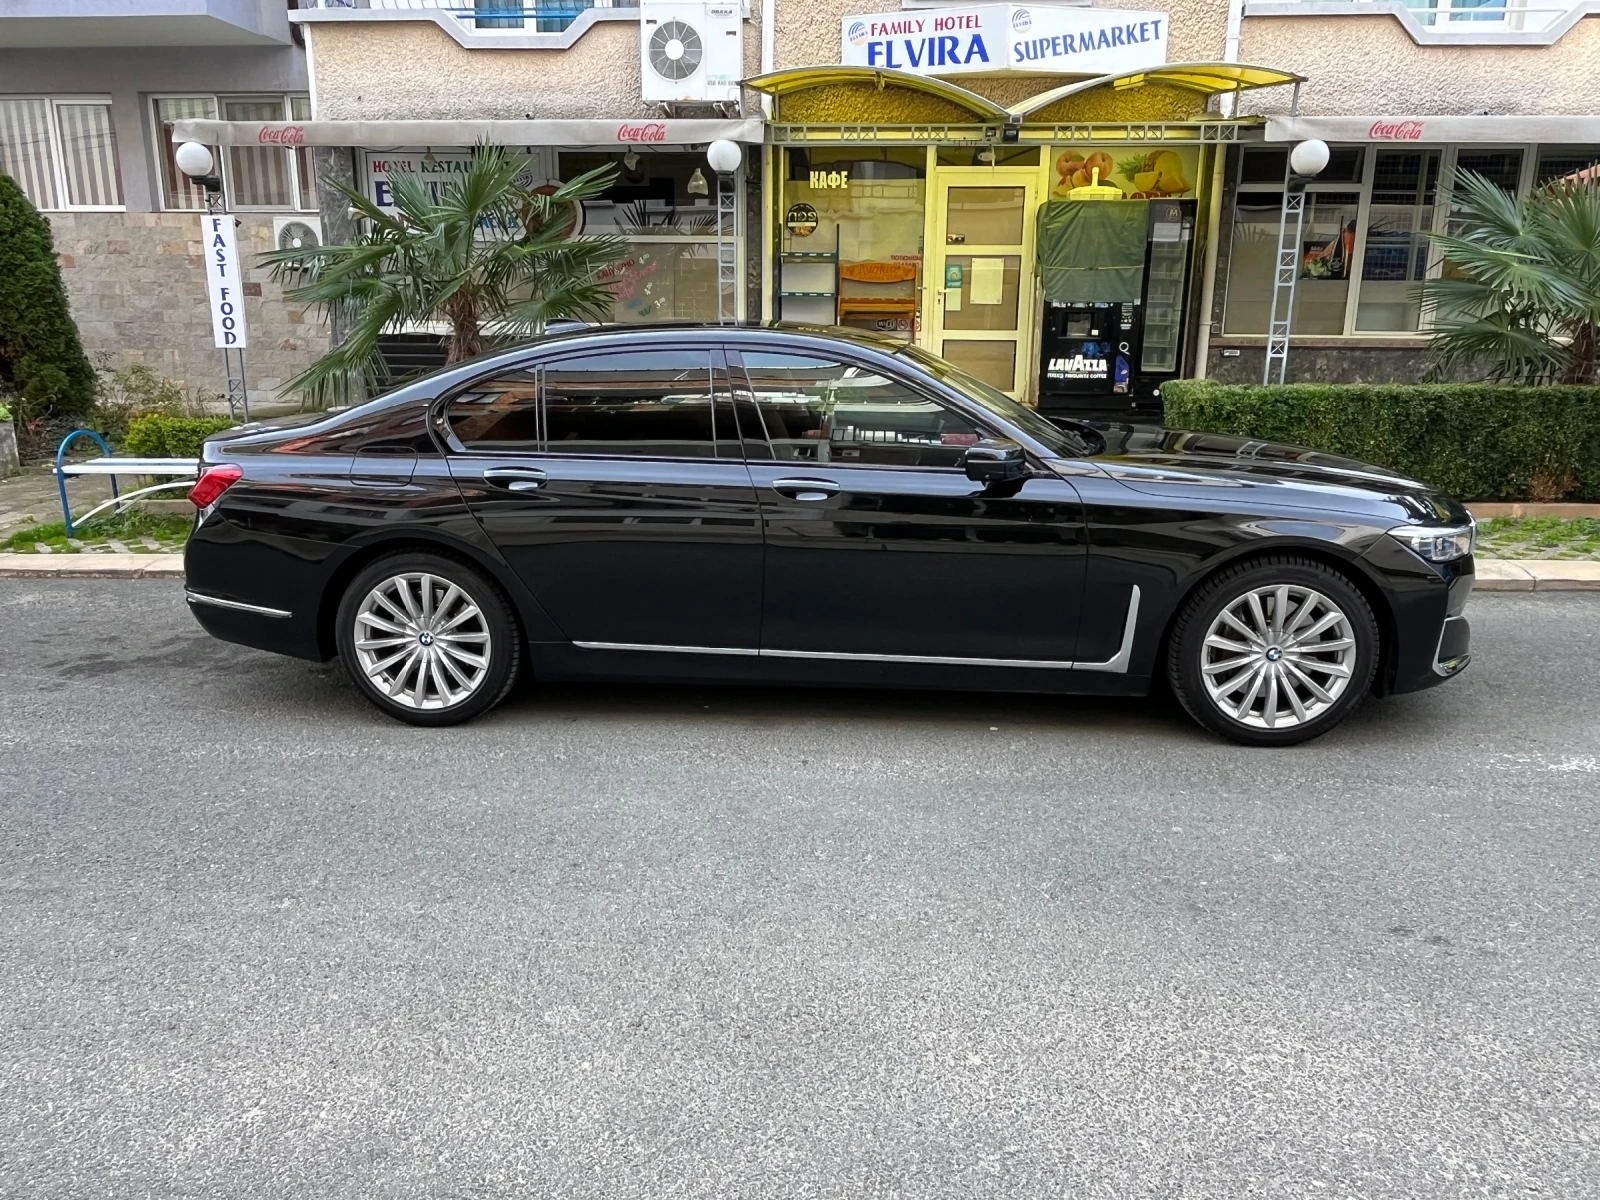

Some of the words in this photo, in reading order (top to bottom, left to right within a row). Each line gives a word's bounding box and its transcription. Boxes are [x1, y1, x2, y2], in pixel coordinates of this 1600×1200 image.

[870, 19, 926, 36] FAMILY
[934, 14, 983, 31] HOTEL
[867, 33, 990, 69] ELVIRA
[1014, 19, 1162, 63] SUPERMARKET
[258, 126, 304, 143] Coca-Cola
[617, 123, 666, 141] Coca-Cola
[1369, 120, 1425, 140] Coca-Cola
[809, 171, 848, 189] КАФЕ
[212, 218, 227, 277] FAST
[220, 287, 237, 345] FOOD
[1047, 354, 1108, 372] LAVAZZA
